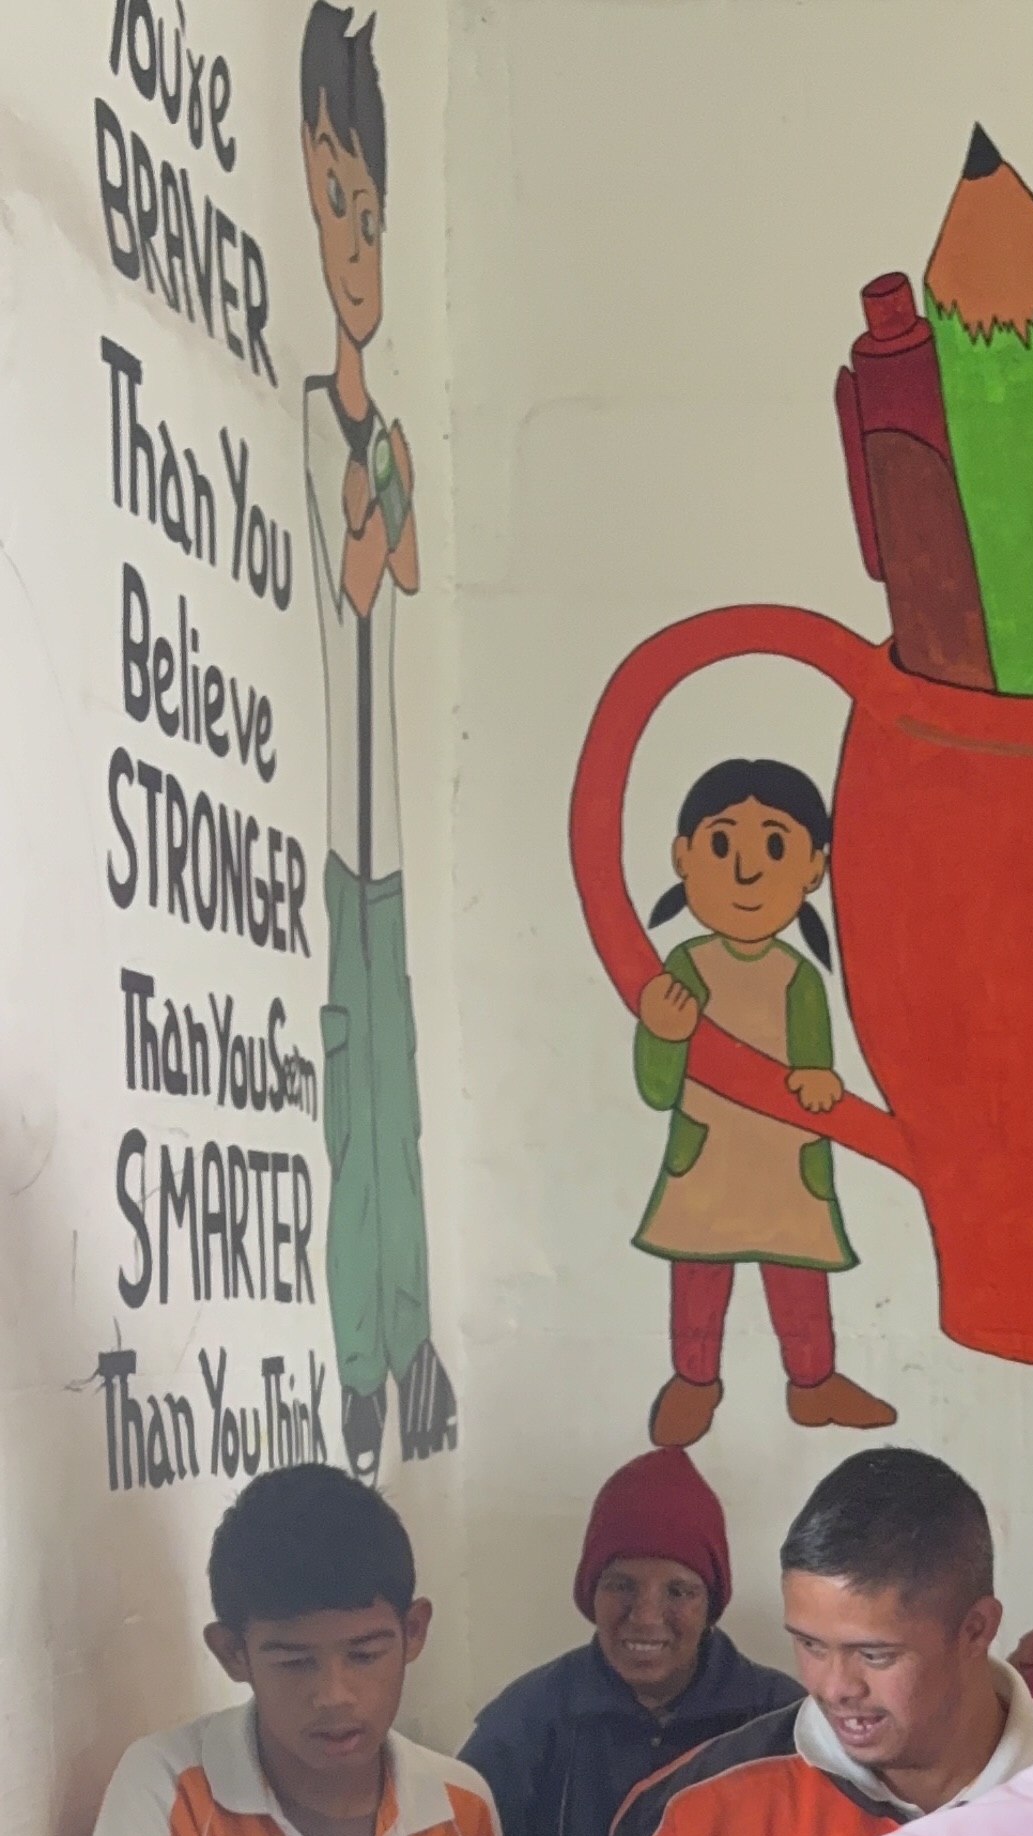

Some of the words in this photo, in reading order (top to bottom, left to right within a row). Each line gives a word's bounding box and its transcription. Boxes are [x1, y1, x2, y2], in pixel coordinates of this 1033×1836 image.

[95, 97, 278, 388] BRAVER
[101, 336, 216, 567] Than
[220, 427, 292, 611] You
[122, 562, 276, 783] Believe
[107, 747, 310, 958] STRONGER
[120, 968, 211, 1096] Than
[208, 992, 267, 1111] You
[116, 1128, 315, 1309] SMARTER
[98, 1349, 200, 1492] Than
[198, 1346, 261, 1479] You
[261, 1349, 328, 1470] Think
